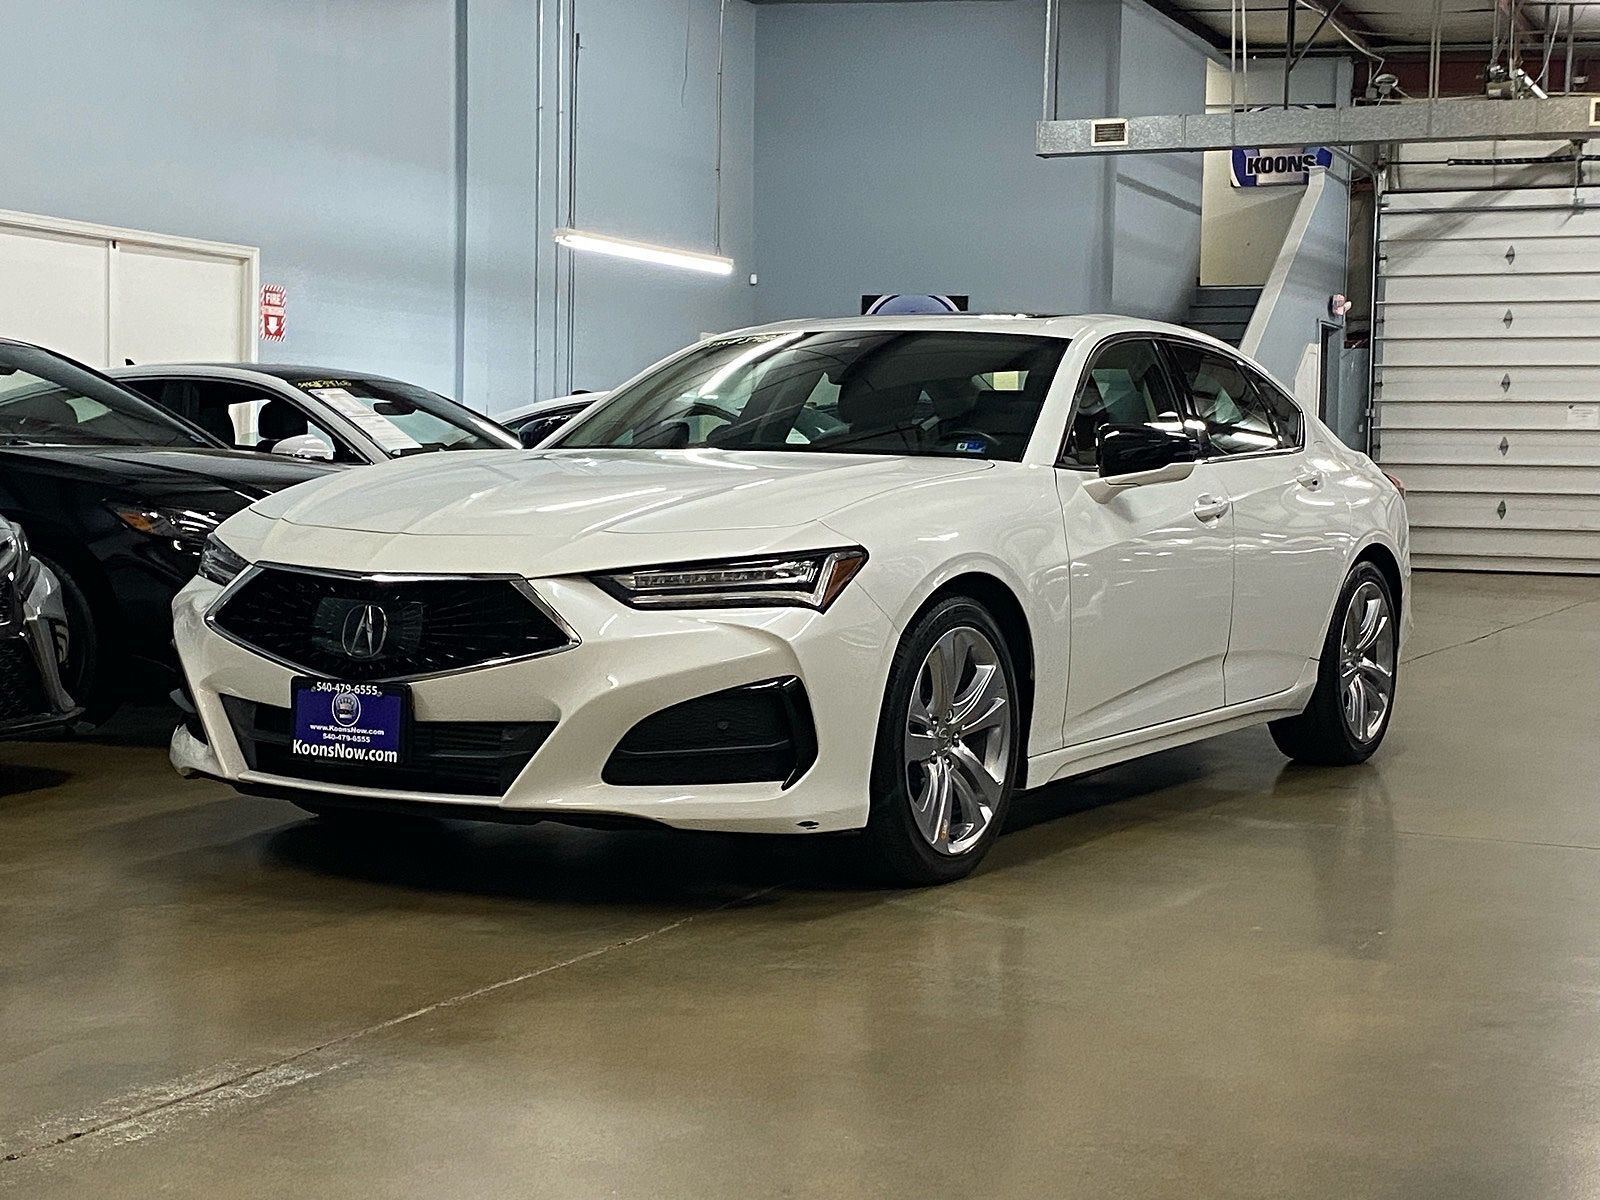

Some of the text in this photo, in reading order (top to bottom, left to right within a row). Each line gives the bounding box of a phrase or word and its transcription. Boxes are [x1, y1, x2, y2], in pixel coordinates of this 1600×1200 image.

[1246, 154, 1317, 175] KOONS
[316, 681, 378, 696] 540-479-6555
[309, 724, 385, 736] www.KoonsNow.com
[292, 739, 398, 763] KoonsNow.com
